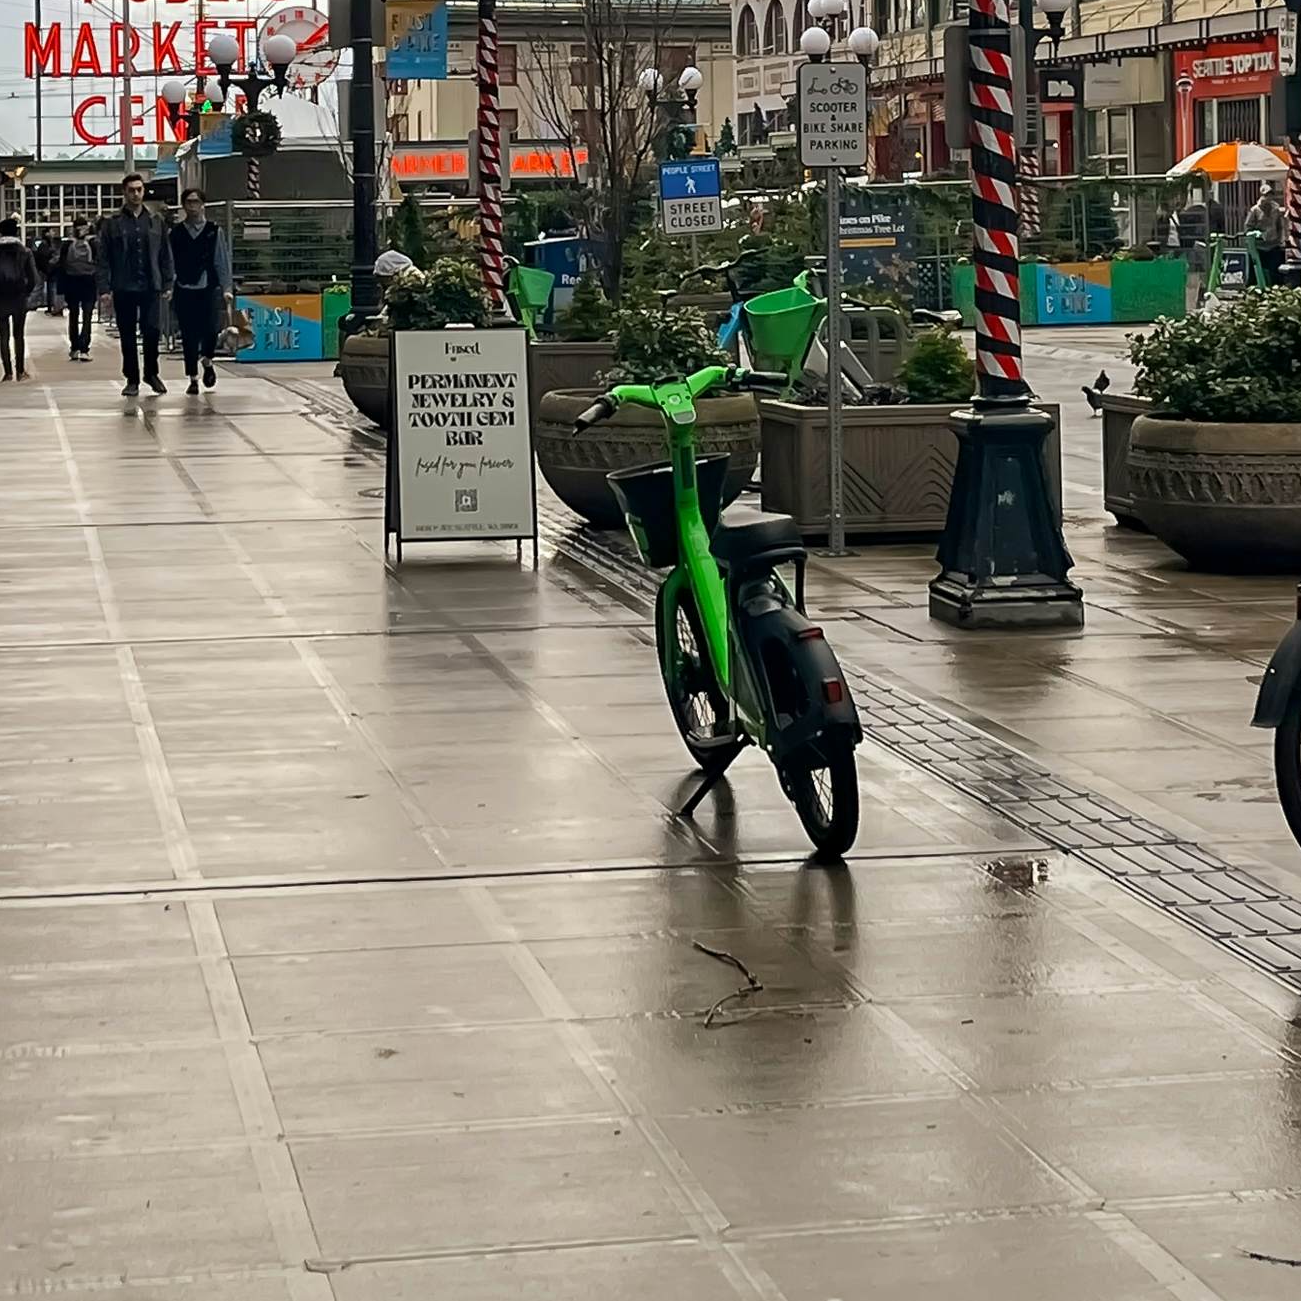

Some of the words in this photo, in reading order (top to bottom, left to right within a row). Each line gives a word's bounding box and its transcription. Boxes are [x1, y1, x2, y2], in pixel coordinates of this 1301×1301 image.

[24, 20, 257, 78] MARKET
[1192, 58, 1233, 79] SEATTLE
[809, 102, 858, 113] SCOOTER
[803, 122, 827, 133] BIKE
[830, 122, 864, 133] SHARE
[809, 140, 858, 150] PARKING
[662, 166, 688, 175] PEOPLE
[690, 163, 717, 173] STREET
[670, 202, 715, 215] STREET
[670, 214, 717, 228] CLOSED
[408, 373, 518, 390] PERMANENT
[411, 392, 497, 409] JEWELRY
[501, 392, 515, 408] &
[408, 412, 473, 428] TOOTH
[476, 411, 516, 427] GEM
[445, 431, 484, 446] BAR
